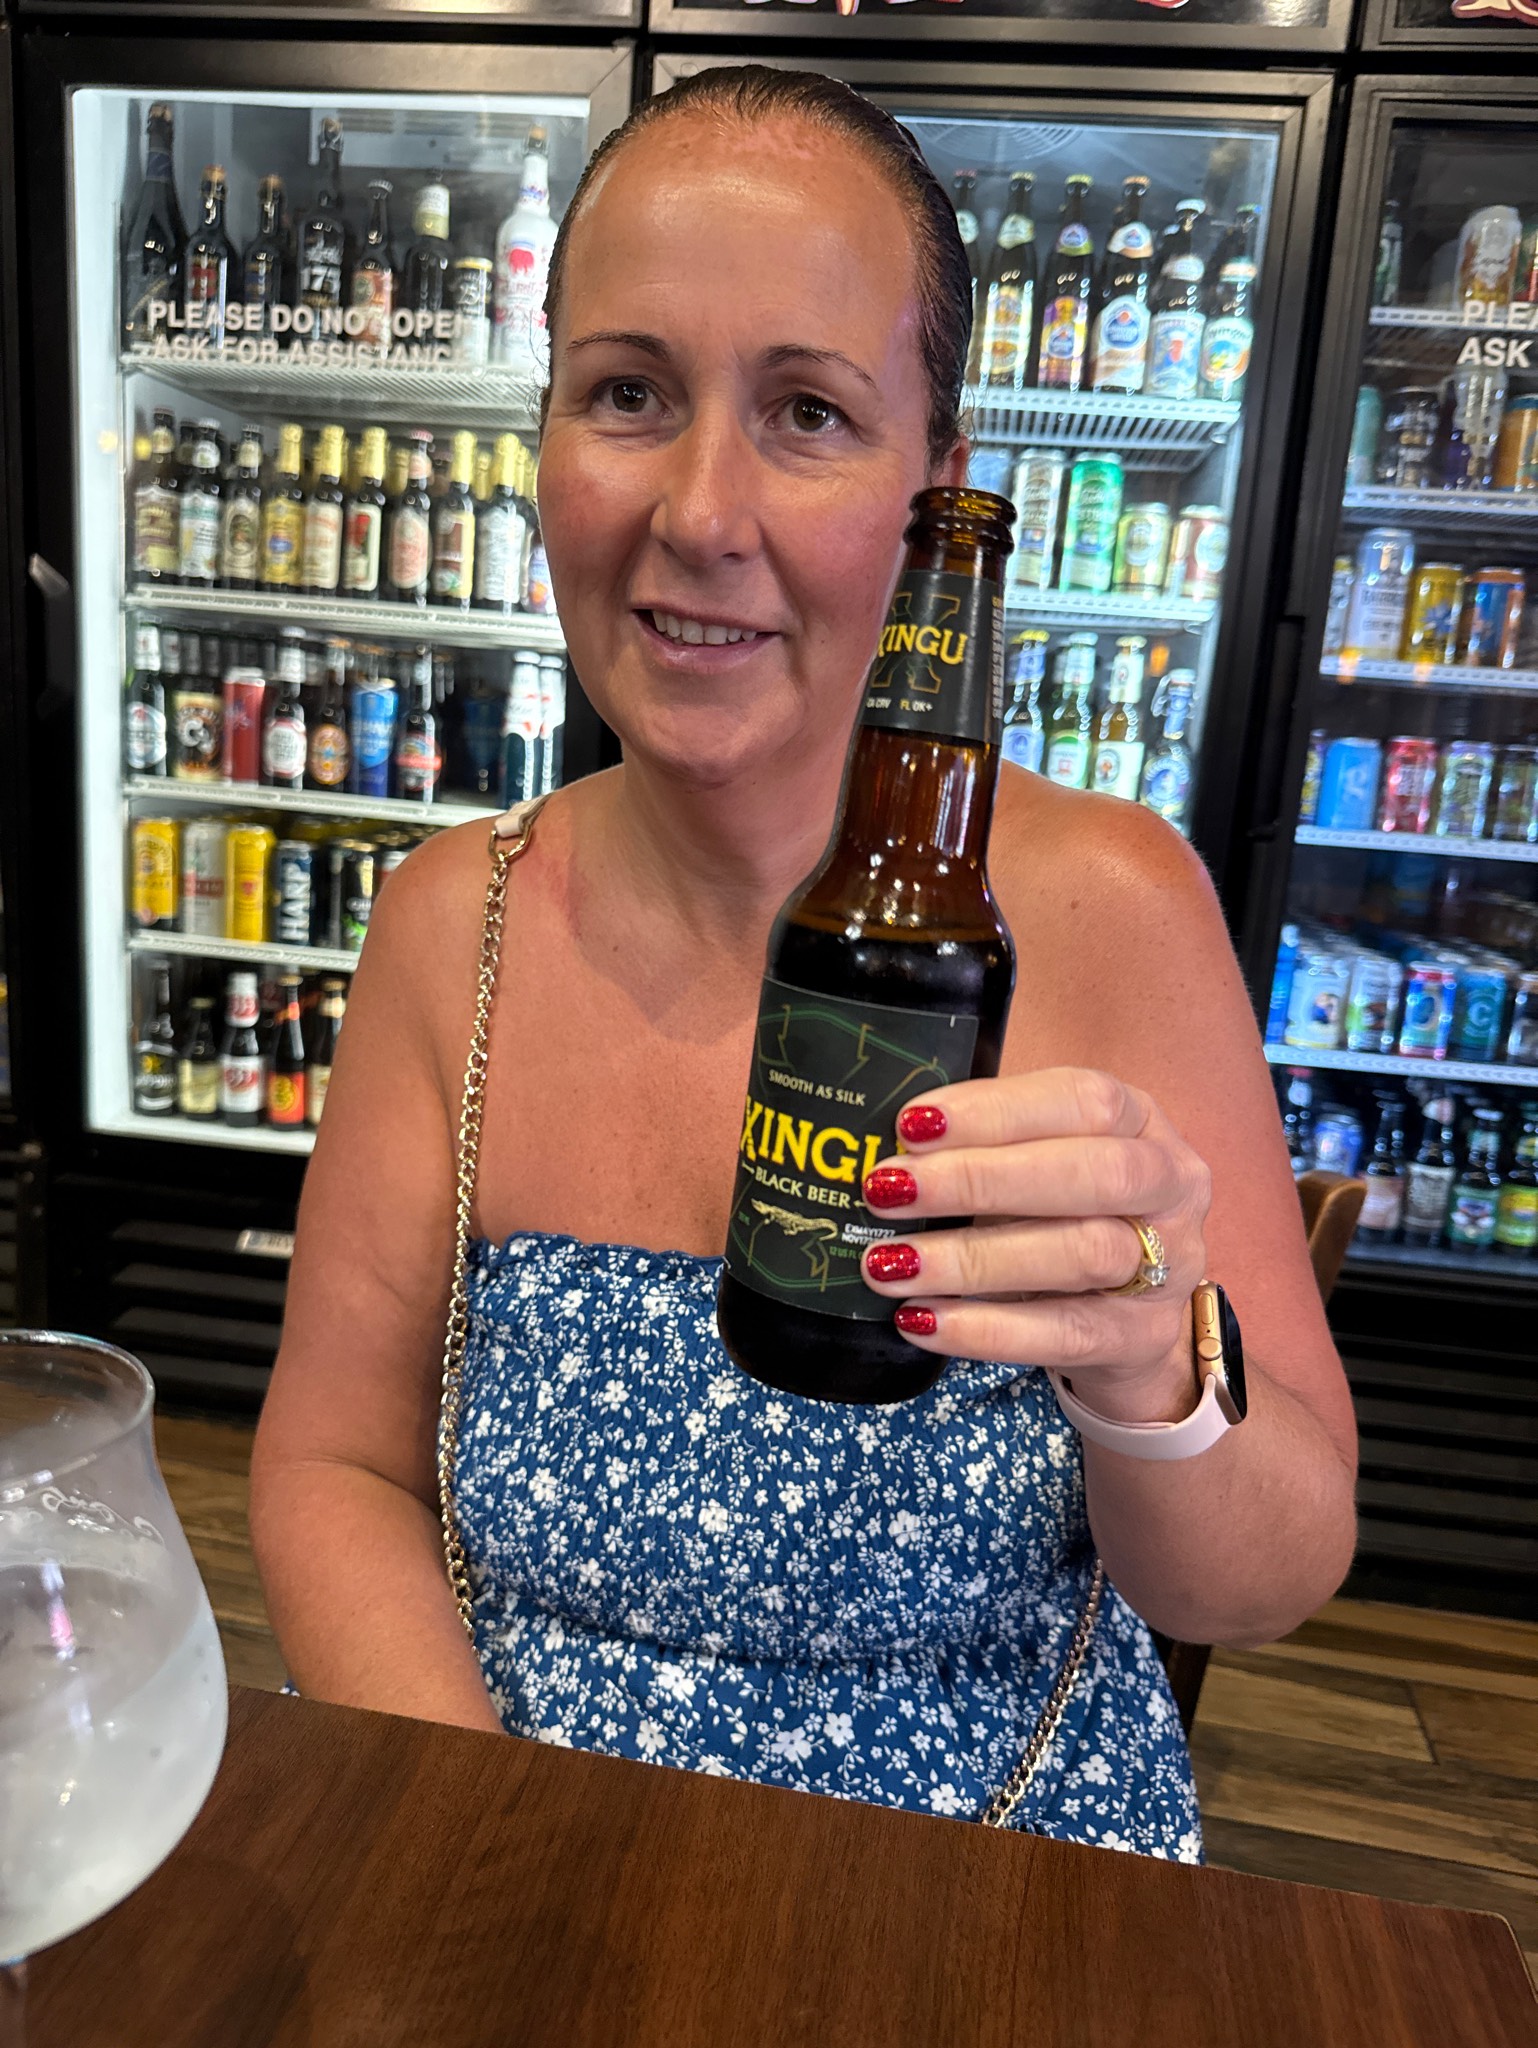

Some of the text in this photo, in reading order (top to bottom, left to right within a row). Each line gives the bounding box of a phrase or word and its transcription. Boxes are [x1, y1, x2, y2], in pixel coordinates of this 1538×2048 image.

[148, 299, 264, 331] PLEASE
[270, 304, 314, 334] DO
[154, 333, 468, 371] ASK FOR ASSISANC
[1456, 336, 1534, 369] ASK
[768, 1068, 867, 1107] SMOOTH AS SILK
[754, 1165, 852, 1210] BLACK BEER
